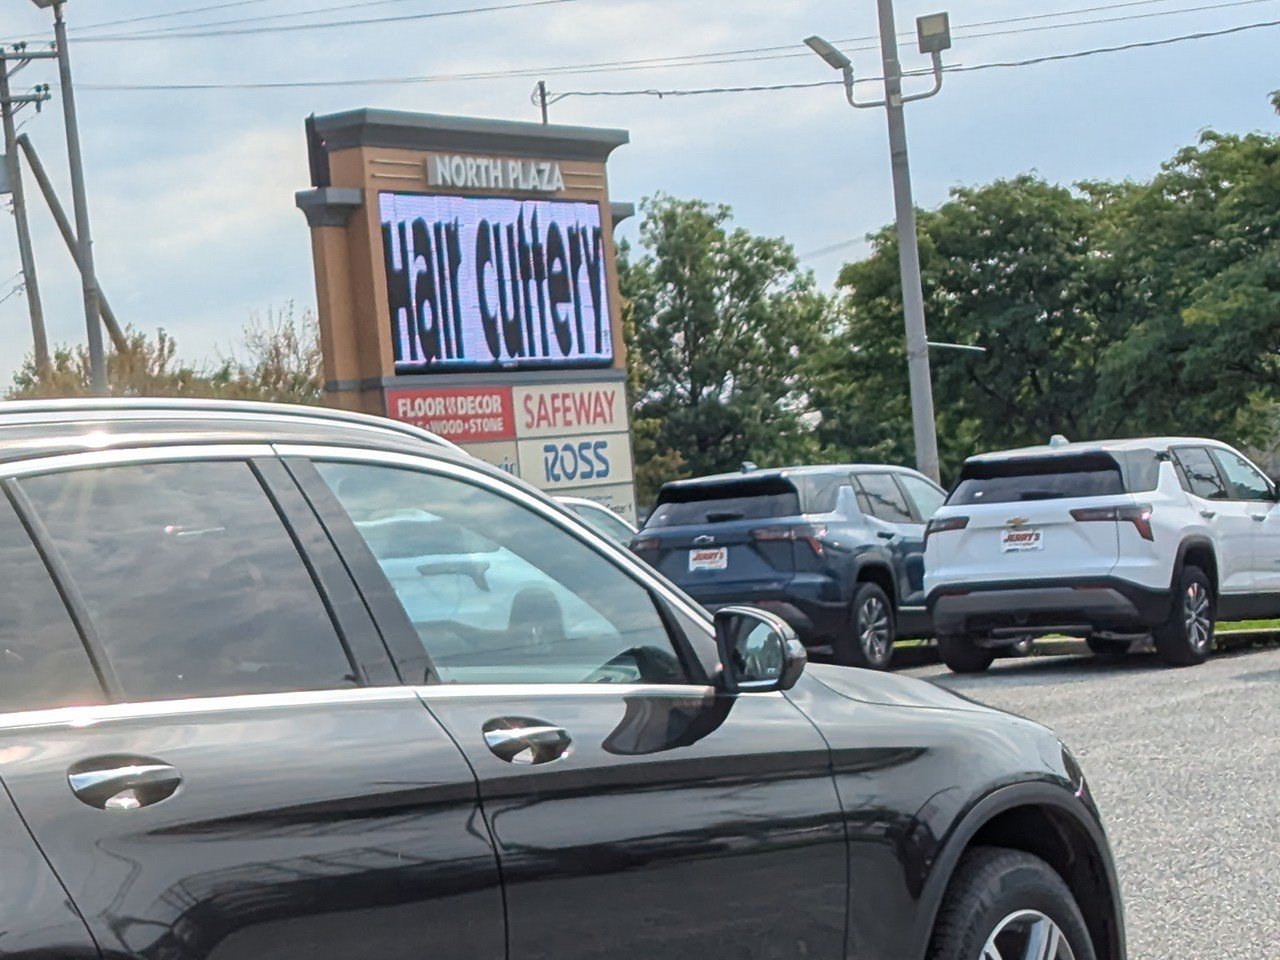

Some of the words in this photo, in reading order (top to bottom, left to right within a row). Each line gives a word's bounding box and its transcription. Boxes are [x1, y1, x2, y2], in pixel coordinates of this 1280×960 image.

[434, 155, 503, 188] NORTH
[508, 158, 565, 191] PLAZA
[381, 215, 465, 362] Hair
[397, 396, 448, 418] FLOOR
[456, 394, 503, 415] DECOR
[523, 390, 616, 430] SAFEWAY
[430, 418, 464, 434] WOOD
[468, 417, 504, 433] STONE
[543, 440, 611, 483] ROSS
